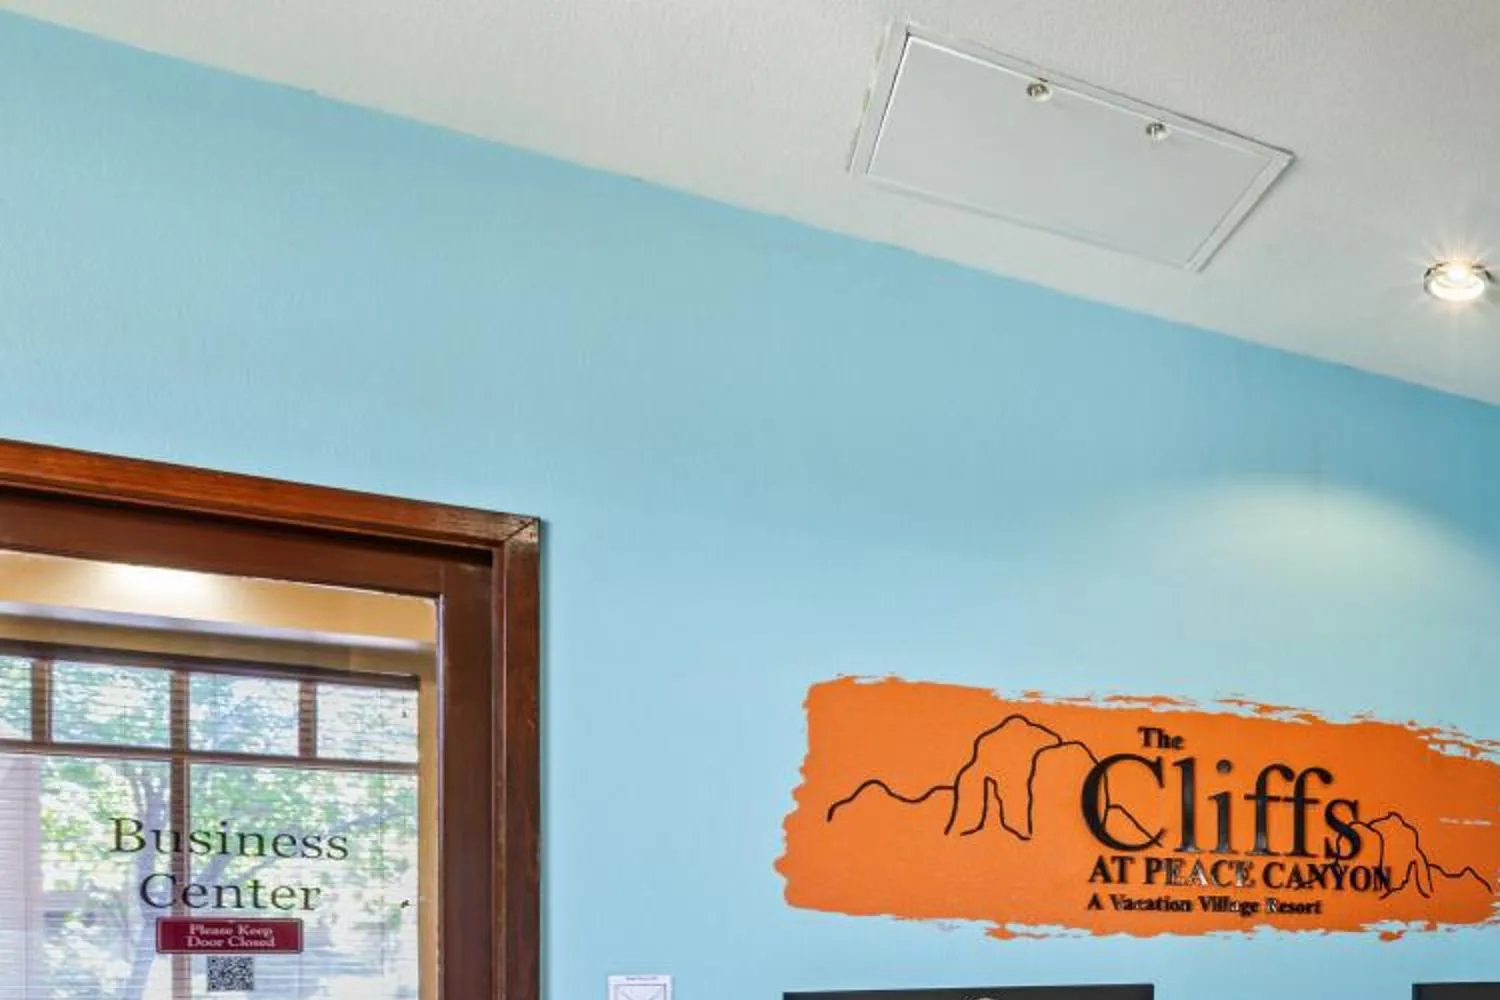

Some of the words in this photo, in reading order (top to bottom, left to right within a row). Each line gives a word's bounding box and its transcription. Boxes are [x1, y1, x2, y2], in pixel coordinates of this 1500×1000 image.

[1137, 726, 1185, 751] The
[1081, 753, 1363, 861] Cliffs
[108, 817, 350, 860] Business
[1087, 855, 1135, 884] AT
[1144, 857, 1255, 888] PEACE
[1262, 861, 1392, 893] CANYON
[139, 873, 322, 911] Center
[1087, 891, 1104, 911] A
[1109, 893, 1192, 912] Vacation
[1198, 895, 1259, 917] Village
[1265, 898, 1322, 914] Resort
[187, 936, 225, 947] Door
[227, 935, 276, 948] Closed
[189, 923, 234, 935] Please
[237, 924, 274, 937] Keep
